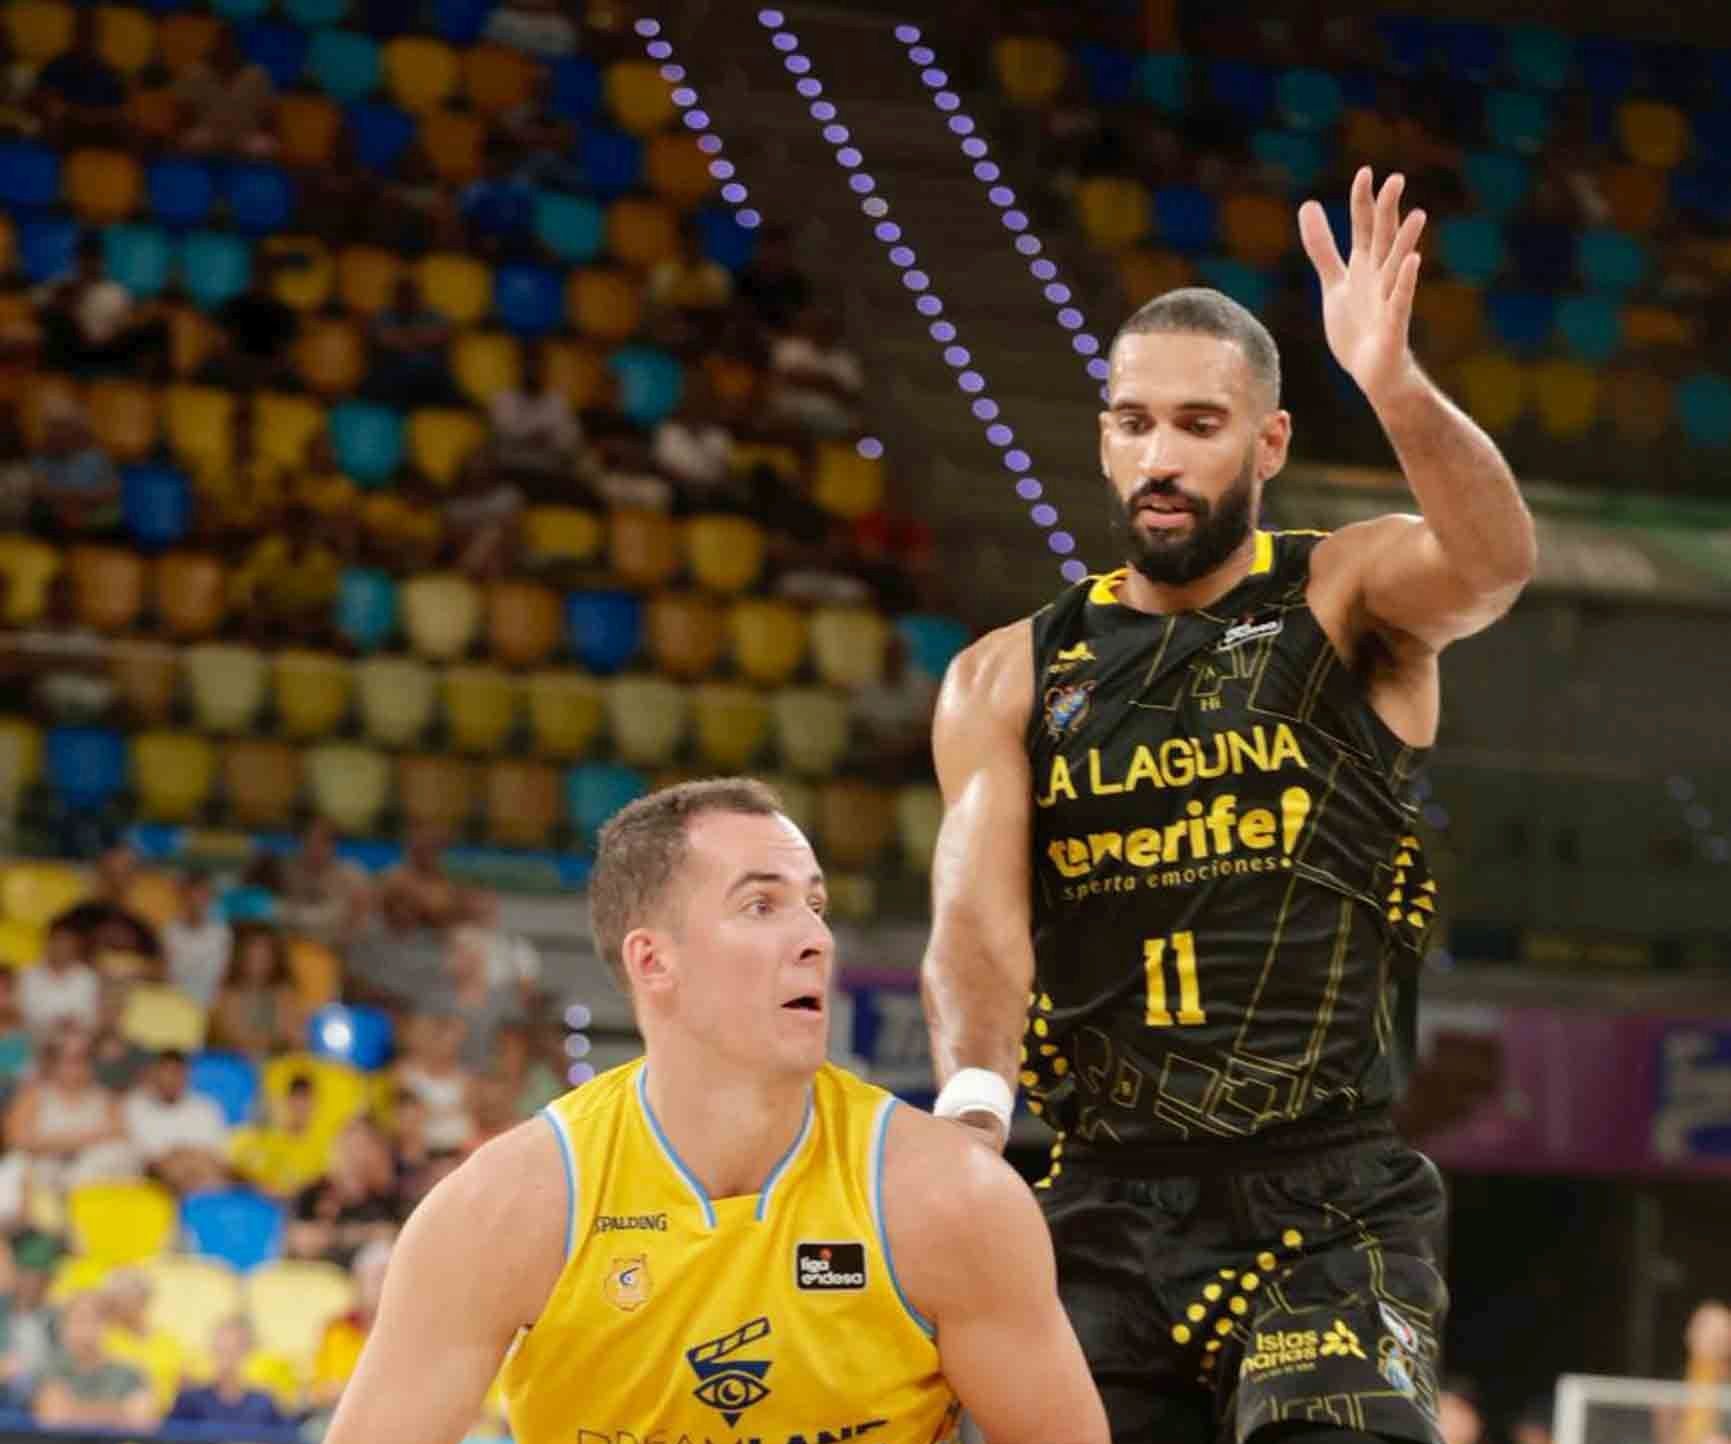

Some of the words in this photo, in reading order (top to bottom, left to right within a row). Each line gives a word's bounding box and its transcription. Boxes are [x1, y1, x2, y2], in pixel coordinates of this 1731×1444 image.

[1088, 722, 1310, 796] LAGUNA
[1145, 856, 1277, 888] emociones
[1143, 931, 1207, 1027] 11
[594, 1213, 668, 1233] SPALDING
